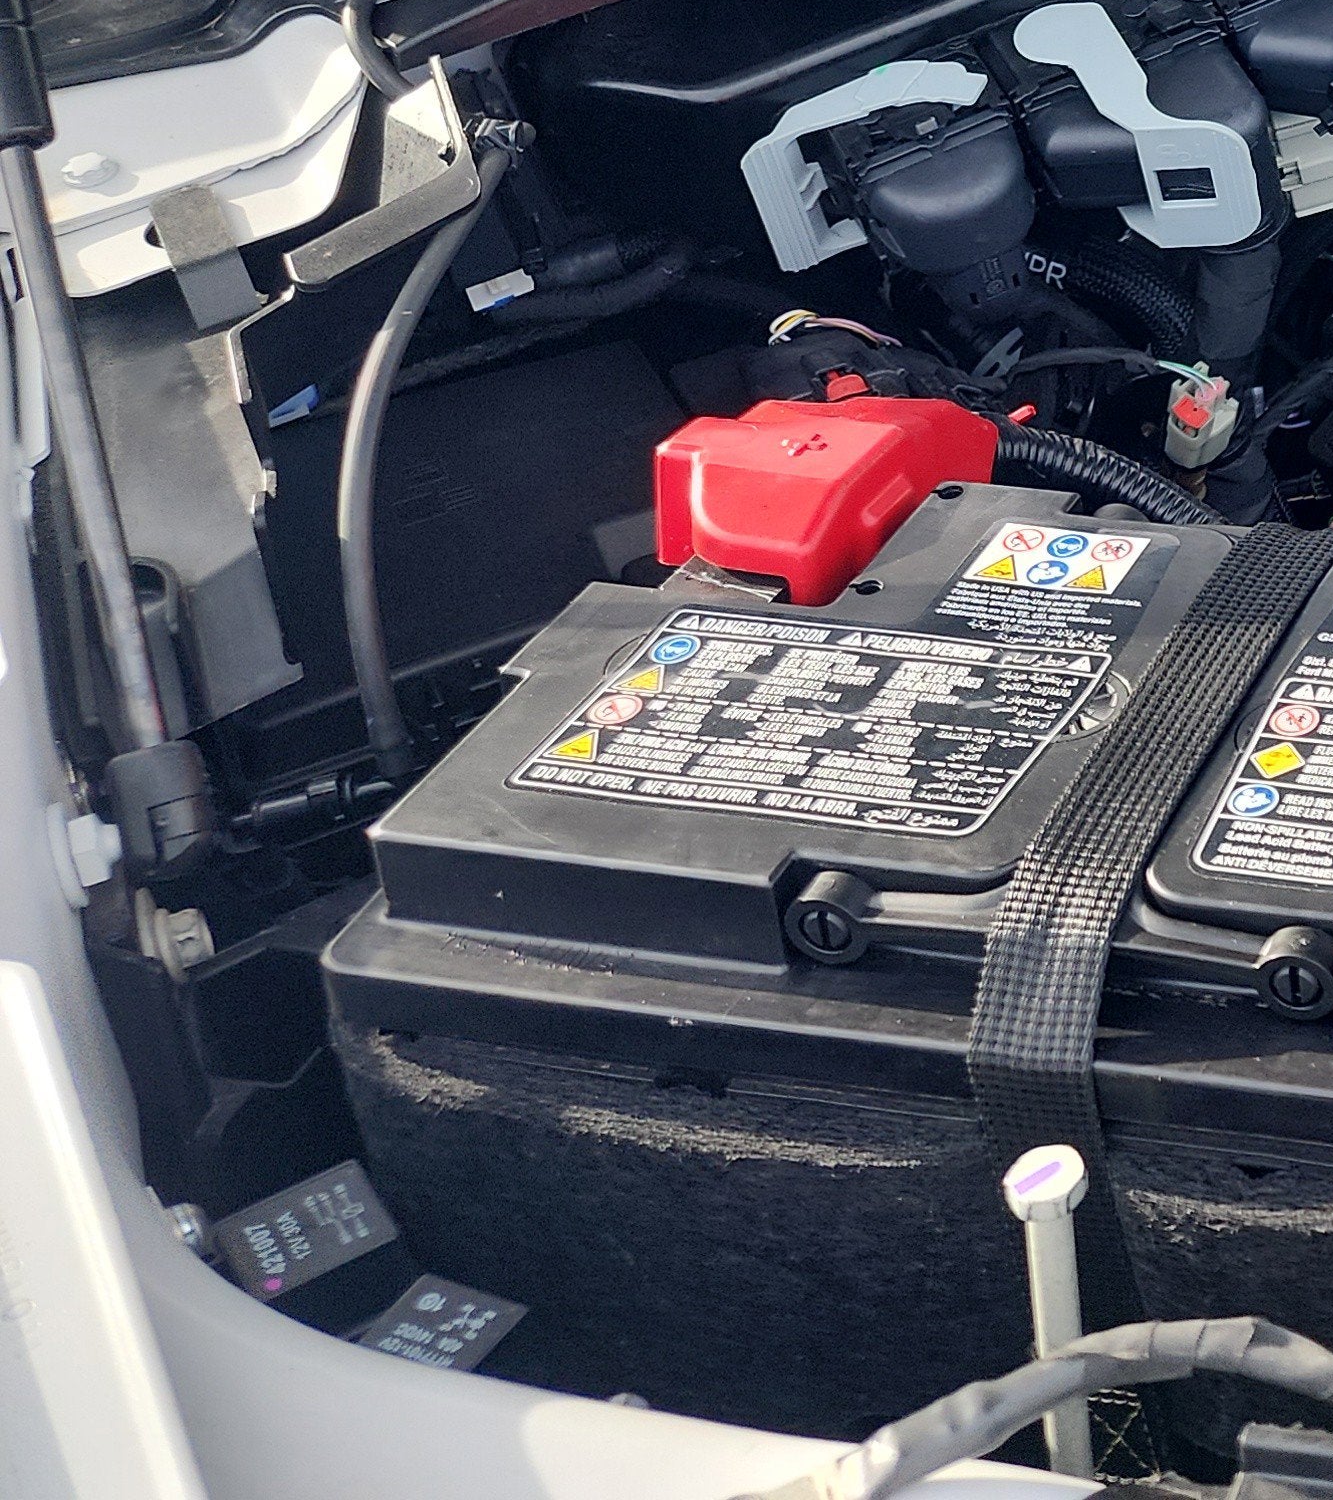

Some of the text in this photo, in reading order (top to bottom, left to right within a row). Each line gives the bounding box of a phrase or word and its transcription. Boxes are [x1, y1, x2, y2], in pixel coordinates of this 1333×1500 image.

[1024, 252, 1066, 290] DR
[697, 618, 832, 642] DANGER/POISON
[859, 635, 996, 660] PELIGRO/VENENO
[1295, 666, 1322, 675] Ford
[530, 766, 640, 789] DO NOT OPEN.
[637, 779, 764, 803] NE PAS OUVRIR.
[1283, 794, 1314, 805] READ
[758, 793, 864, 815] NO LA ABRA.
[1276, 804, 1304, 816] LIRE
[1303, 807, 1325, 818] LES
[1224, 831, 1261, 842] Lead
[1260, 835, 1292, 846] Acid
[1290, 853, 1333, 866] plomb
